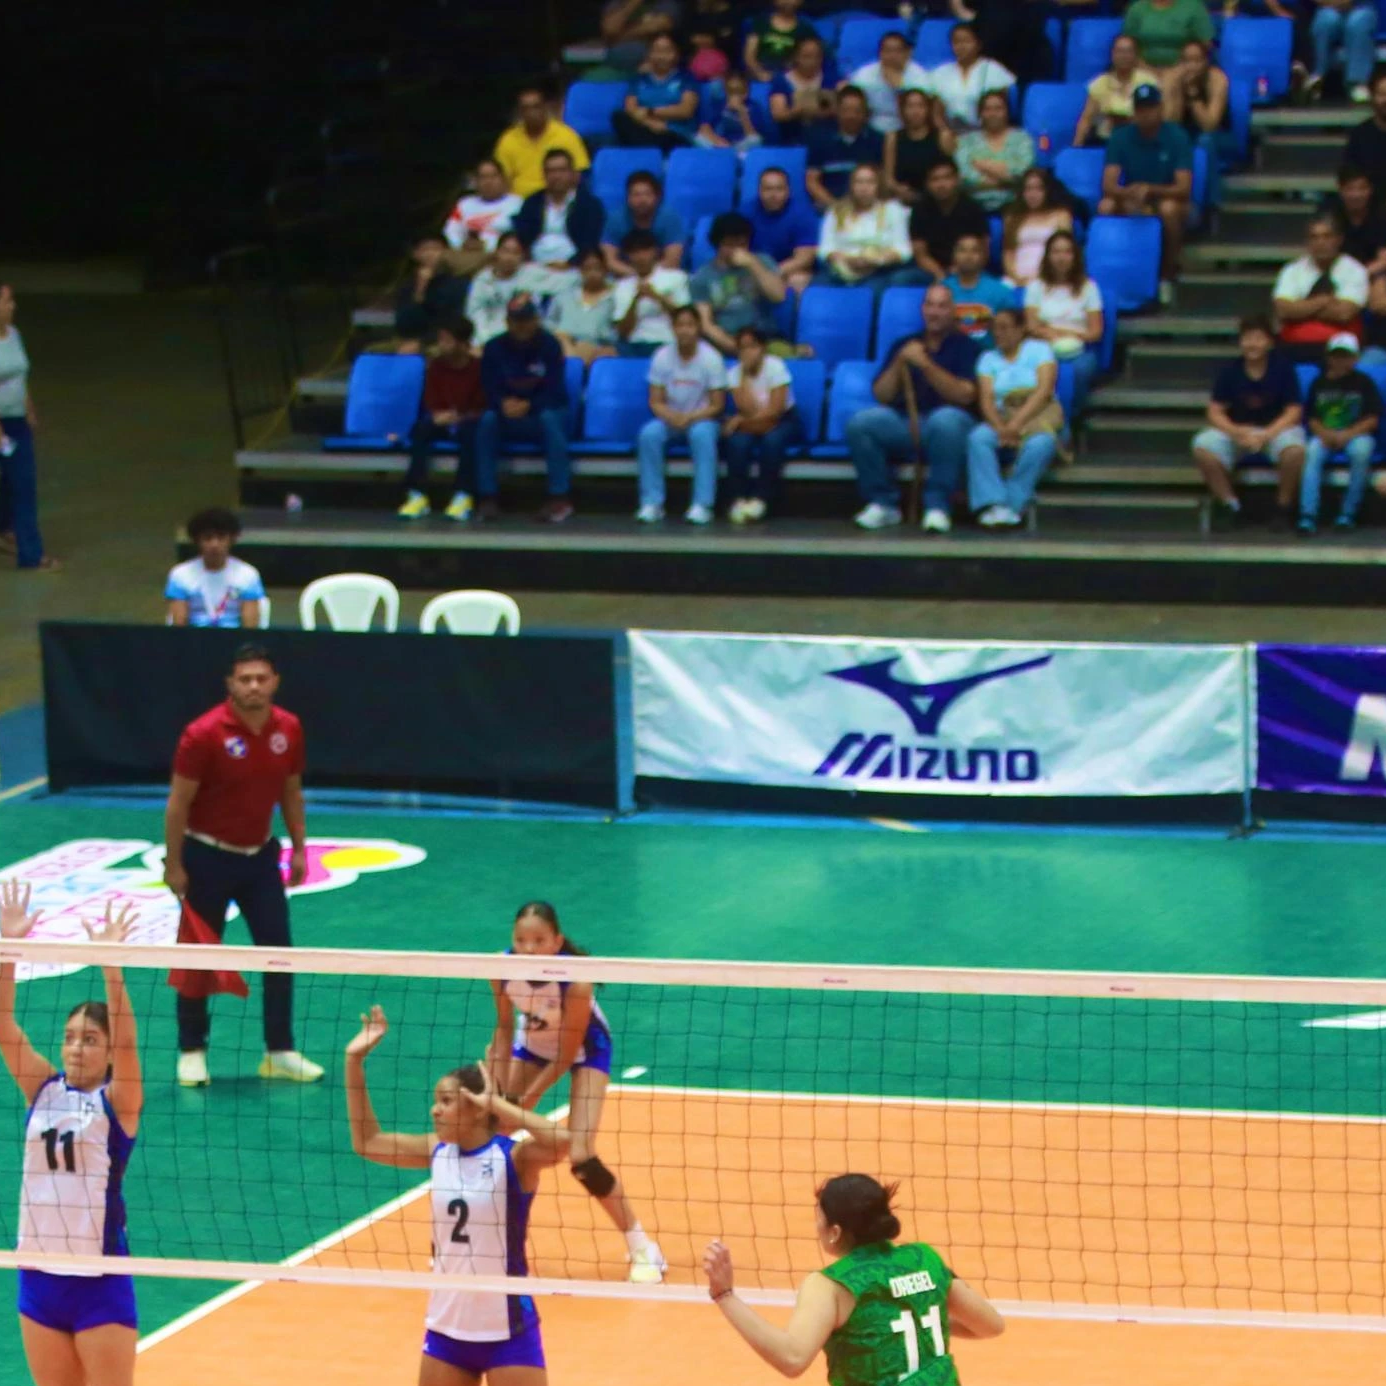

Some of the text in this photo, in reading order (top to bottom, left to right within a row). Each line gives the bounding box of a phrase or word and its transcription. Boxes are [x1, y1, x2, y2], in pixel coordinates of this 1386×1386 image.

[813, 732, 1040, 782] MIZUNO
[41, 1128, 76, 1172] 11
[447, 1198, 470, 1244] 2
[890, 1305, 945, 1382] 11
